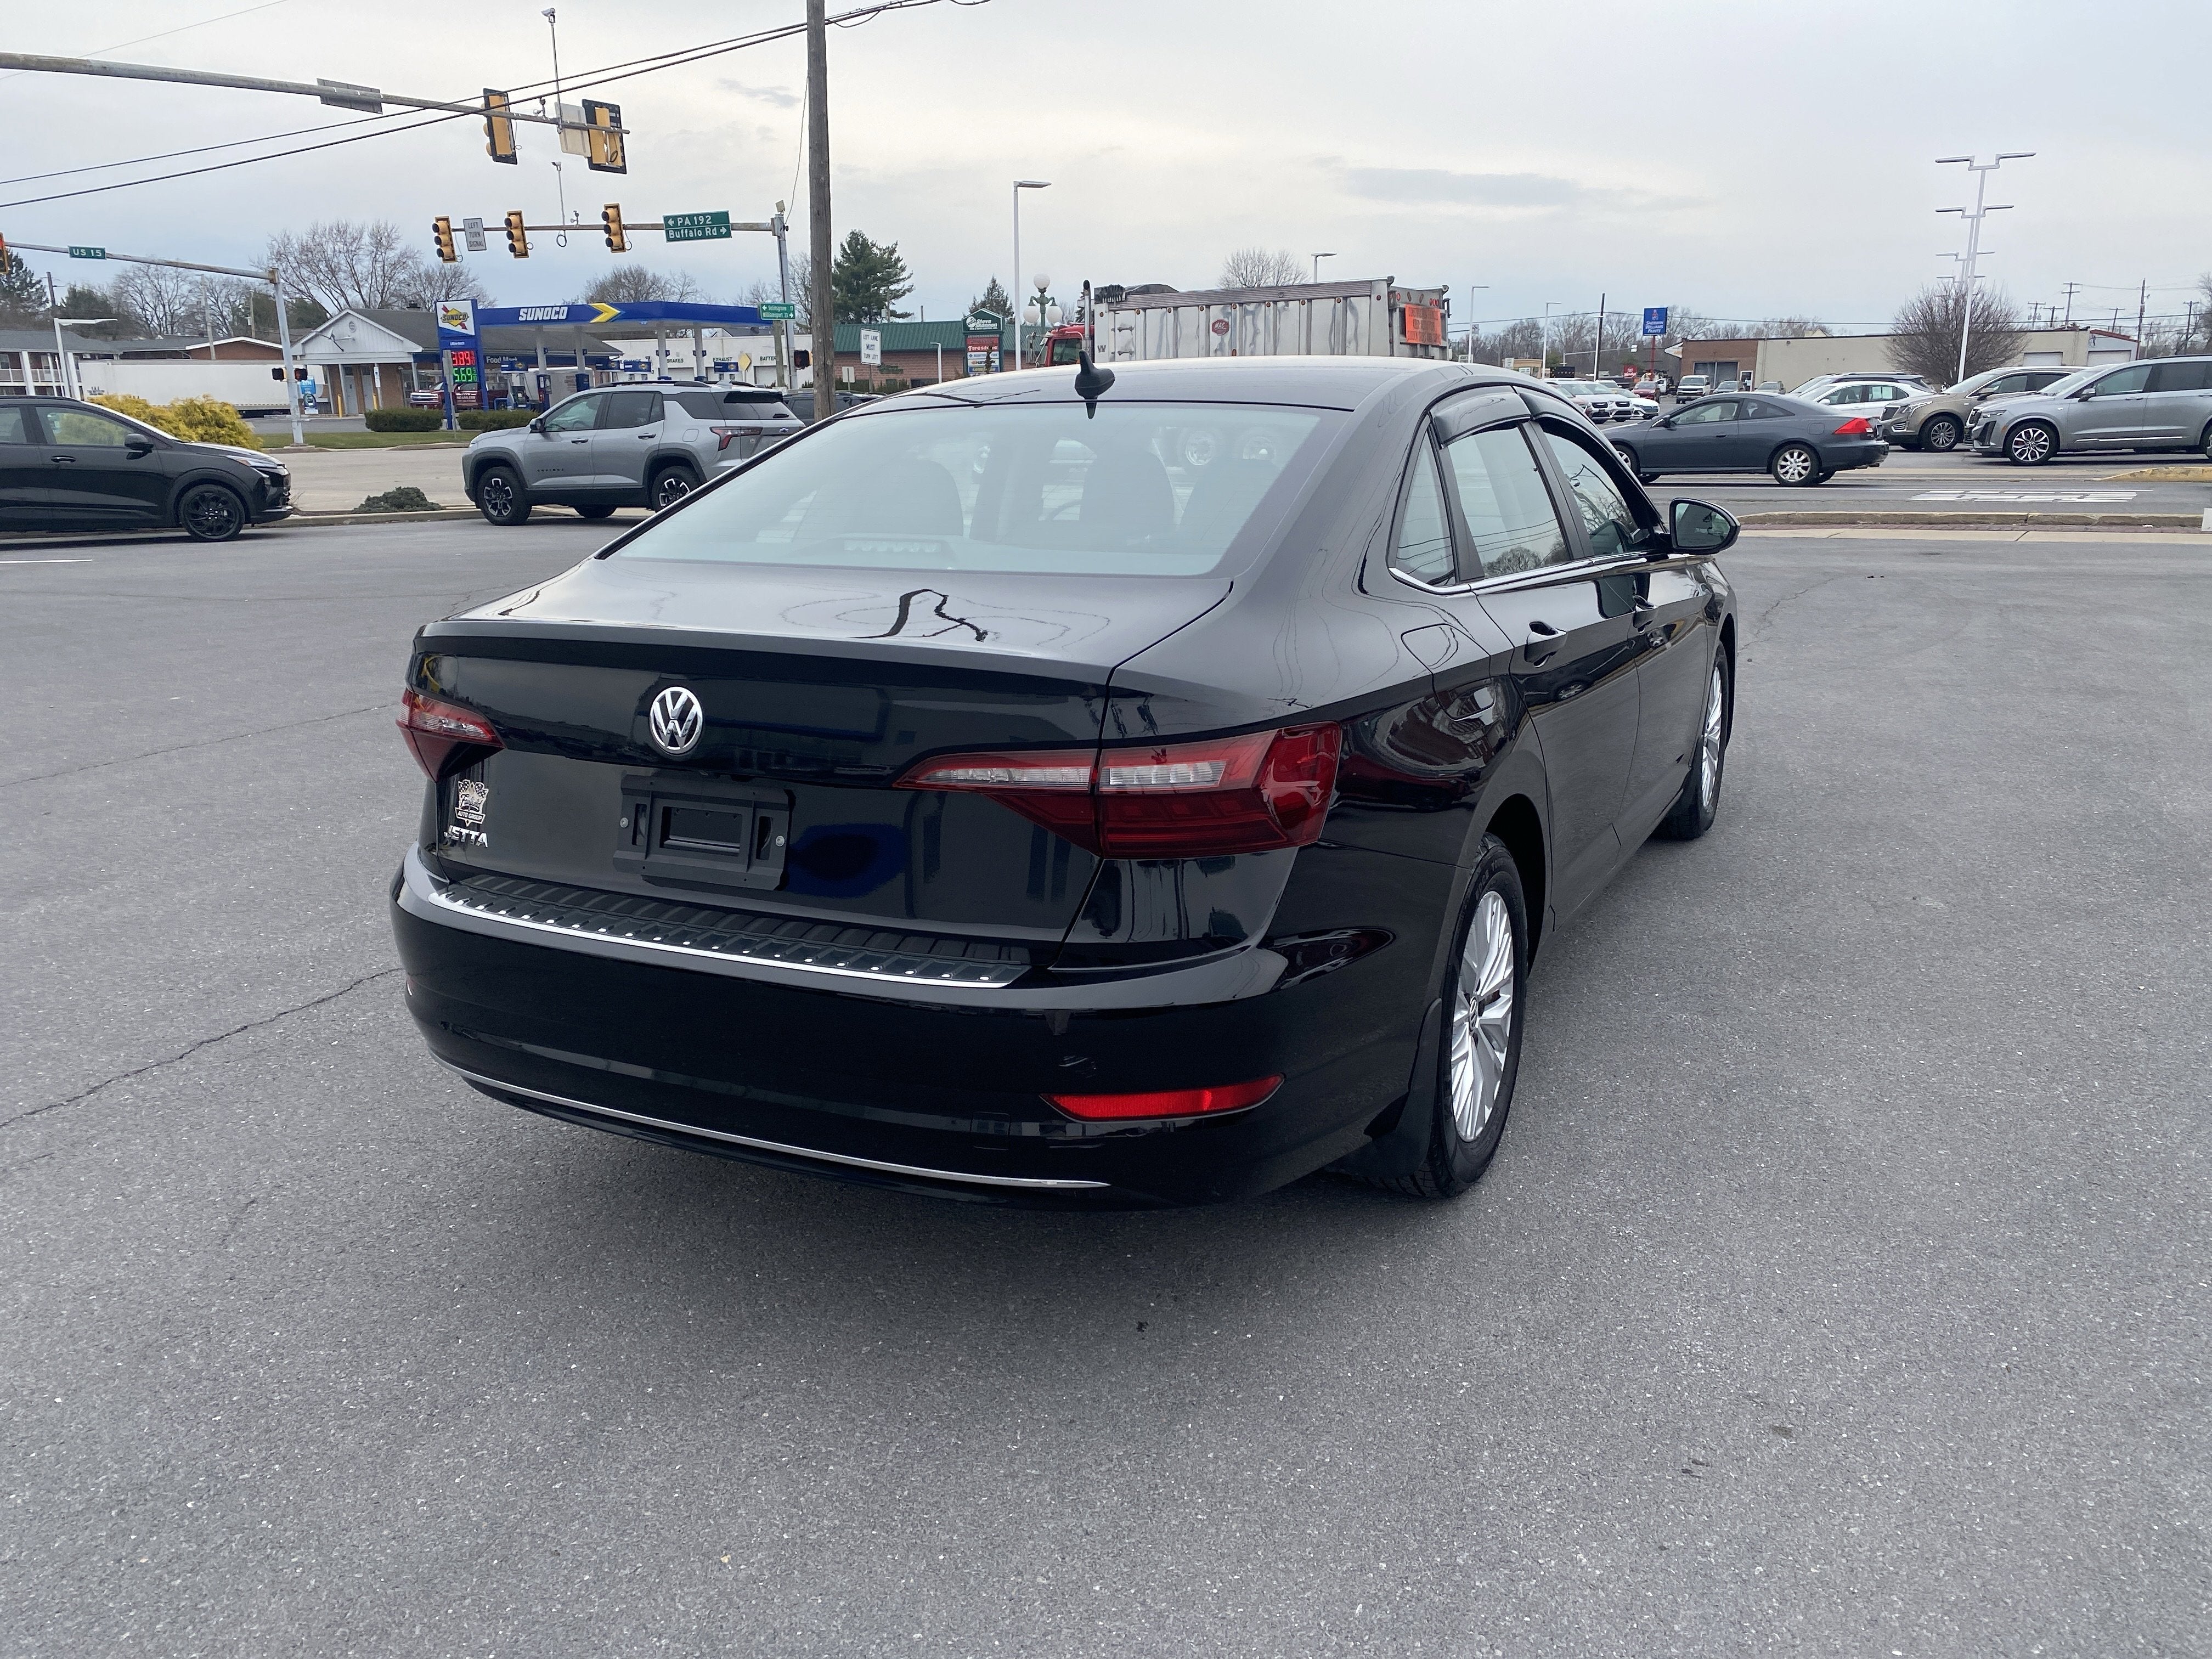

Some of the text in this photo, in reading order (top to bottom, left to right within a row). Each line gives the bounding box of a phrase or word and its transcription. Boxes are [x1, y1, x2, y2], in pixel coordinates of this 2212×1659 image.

[677, 215, 712, 227] PA 192
[668, 227, 717, 239] Buffalo Rd
[518, 306, 568, 321] SUNOCO
[468, 812, 483, 821] GROUP
[443, 825, 488, 848] JETTA
